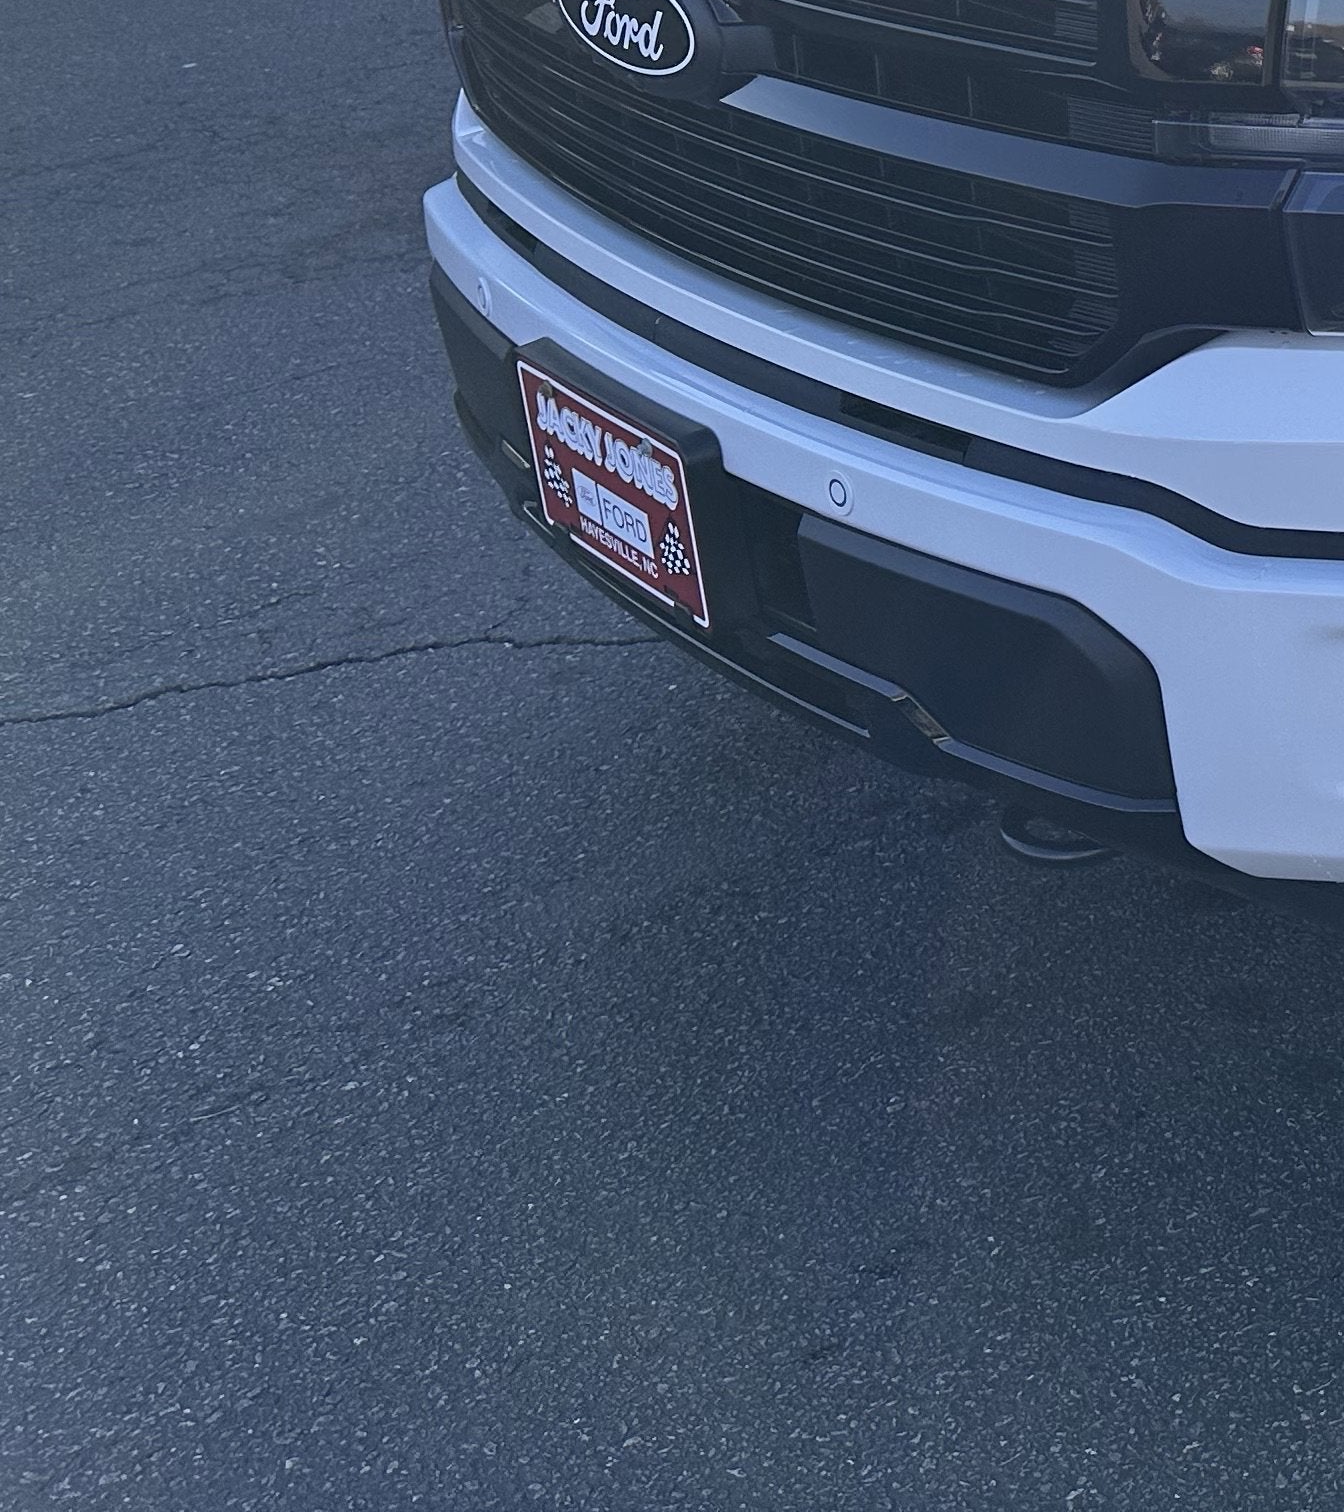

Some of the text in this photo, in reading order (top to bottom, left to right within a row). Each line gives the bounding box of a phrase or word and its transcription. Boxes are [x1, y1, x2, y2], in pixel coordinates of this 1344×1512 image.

[536, 390, 679, 511] JACKY JONES
[602, 498, 647, 543] FORD
